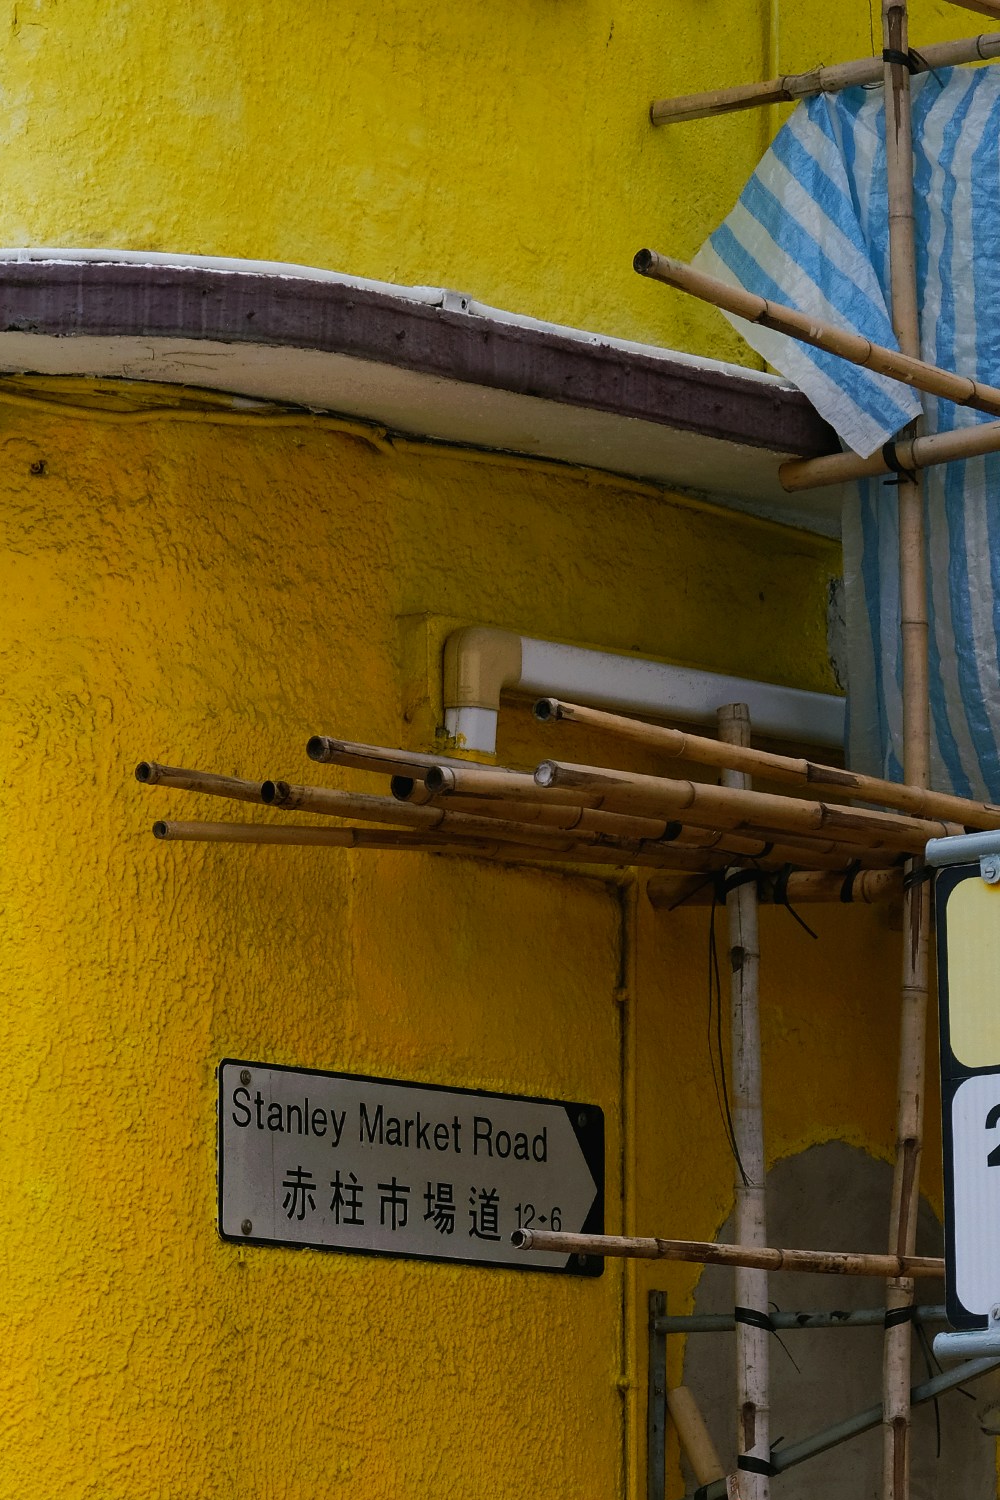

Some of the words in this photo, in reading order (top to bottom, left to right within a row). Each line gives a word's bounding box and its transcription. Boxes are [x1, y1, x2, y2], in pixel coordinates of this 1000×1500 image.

[232, 1087, 347, 1148] Stanley
[359, 1102, 462, 1154] Market
[473, 1115, 548, 1163] Road
[282, 1165, 502, 1242] 赤柱市場道
